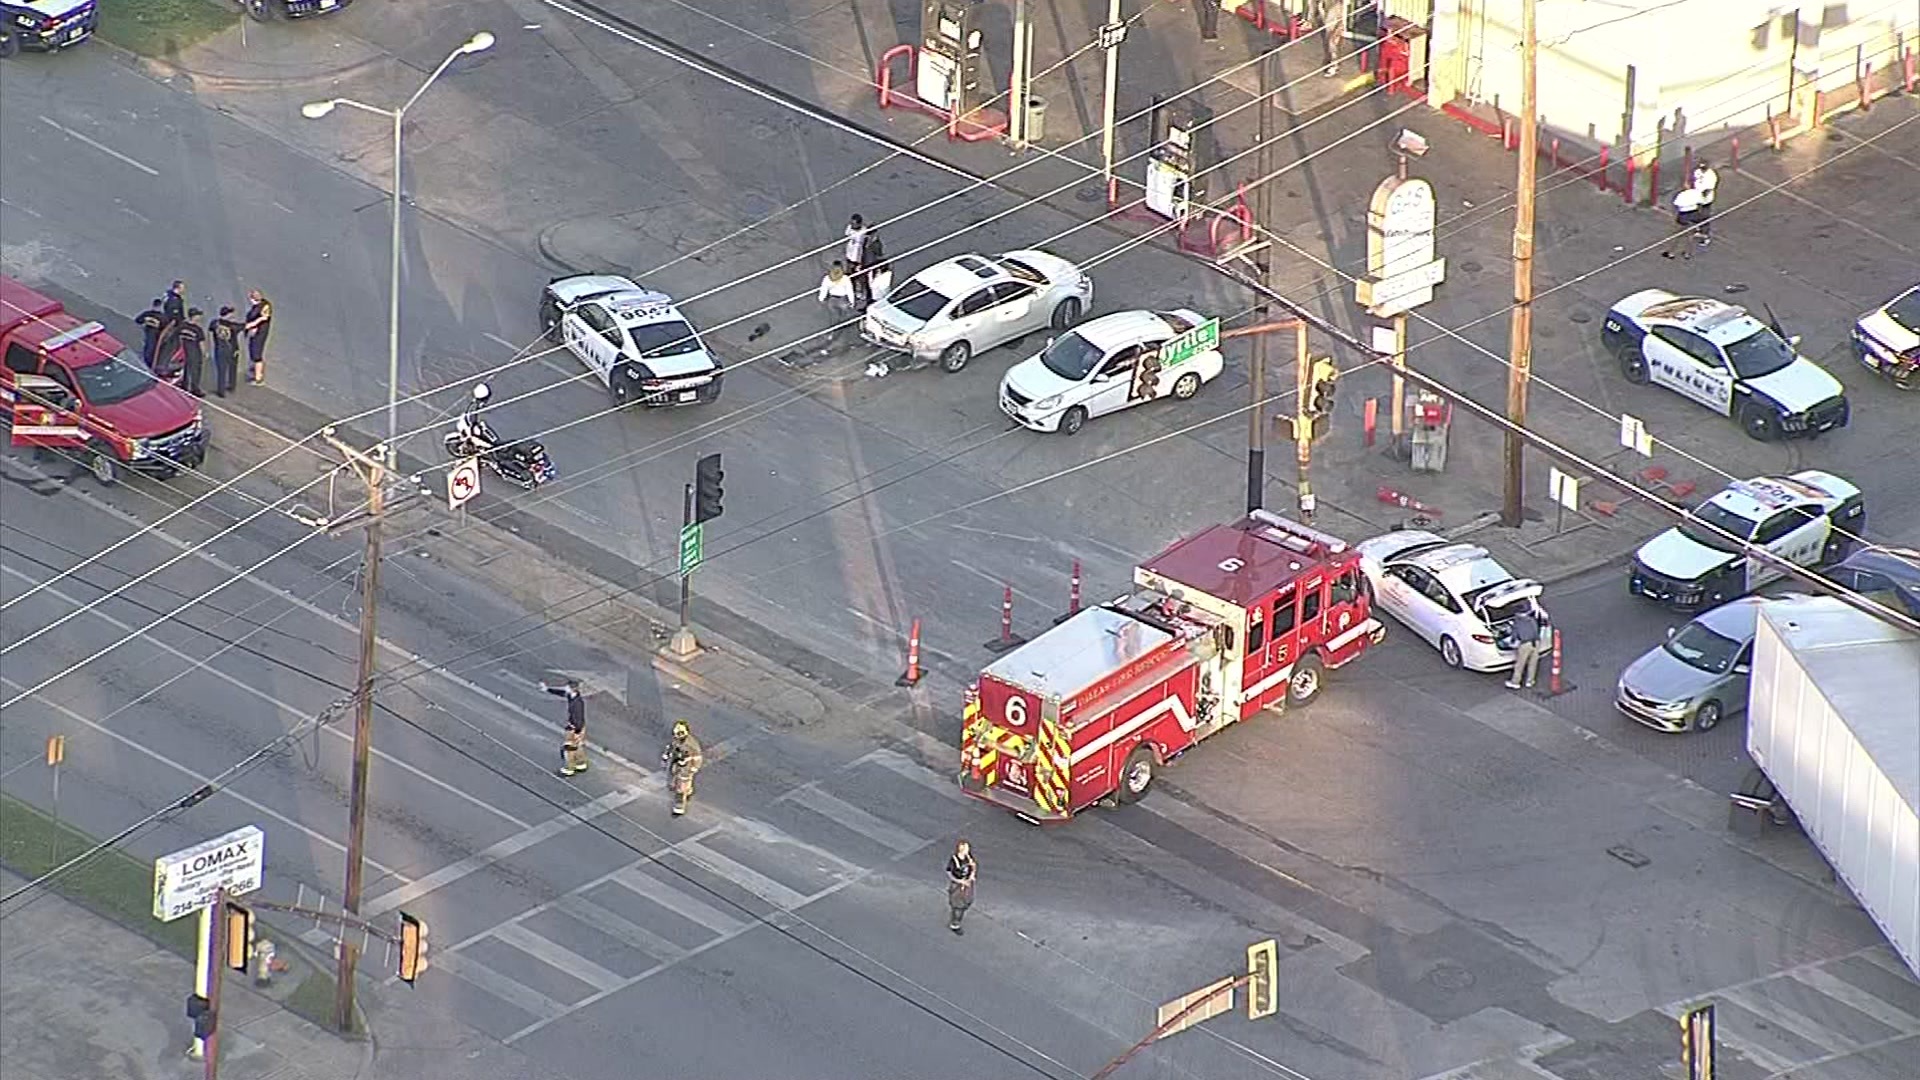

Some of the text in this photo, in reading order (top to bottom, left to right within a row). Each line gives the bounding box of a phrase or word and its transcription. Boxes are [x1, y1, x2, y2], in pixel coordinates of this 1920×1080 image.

[1218, 558, 1245, 572] 6
[1005, 695, 1028, 726] 6
[183, 841, 248, 876] LOMAX
